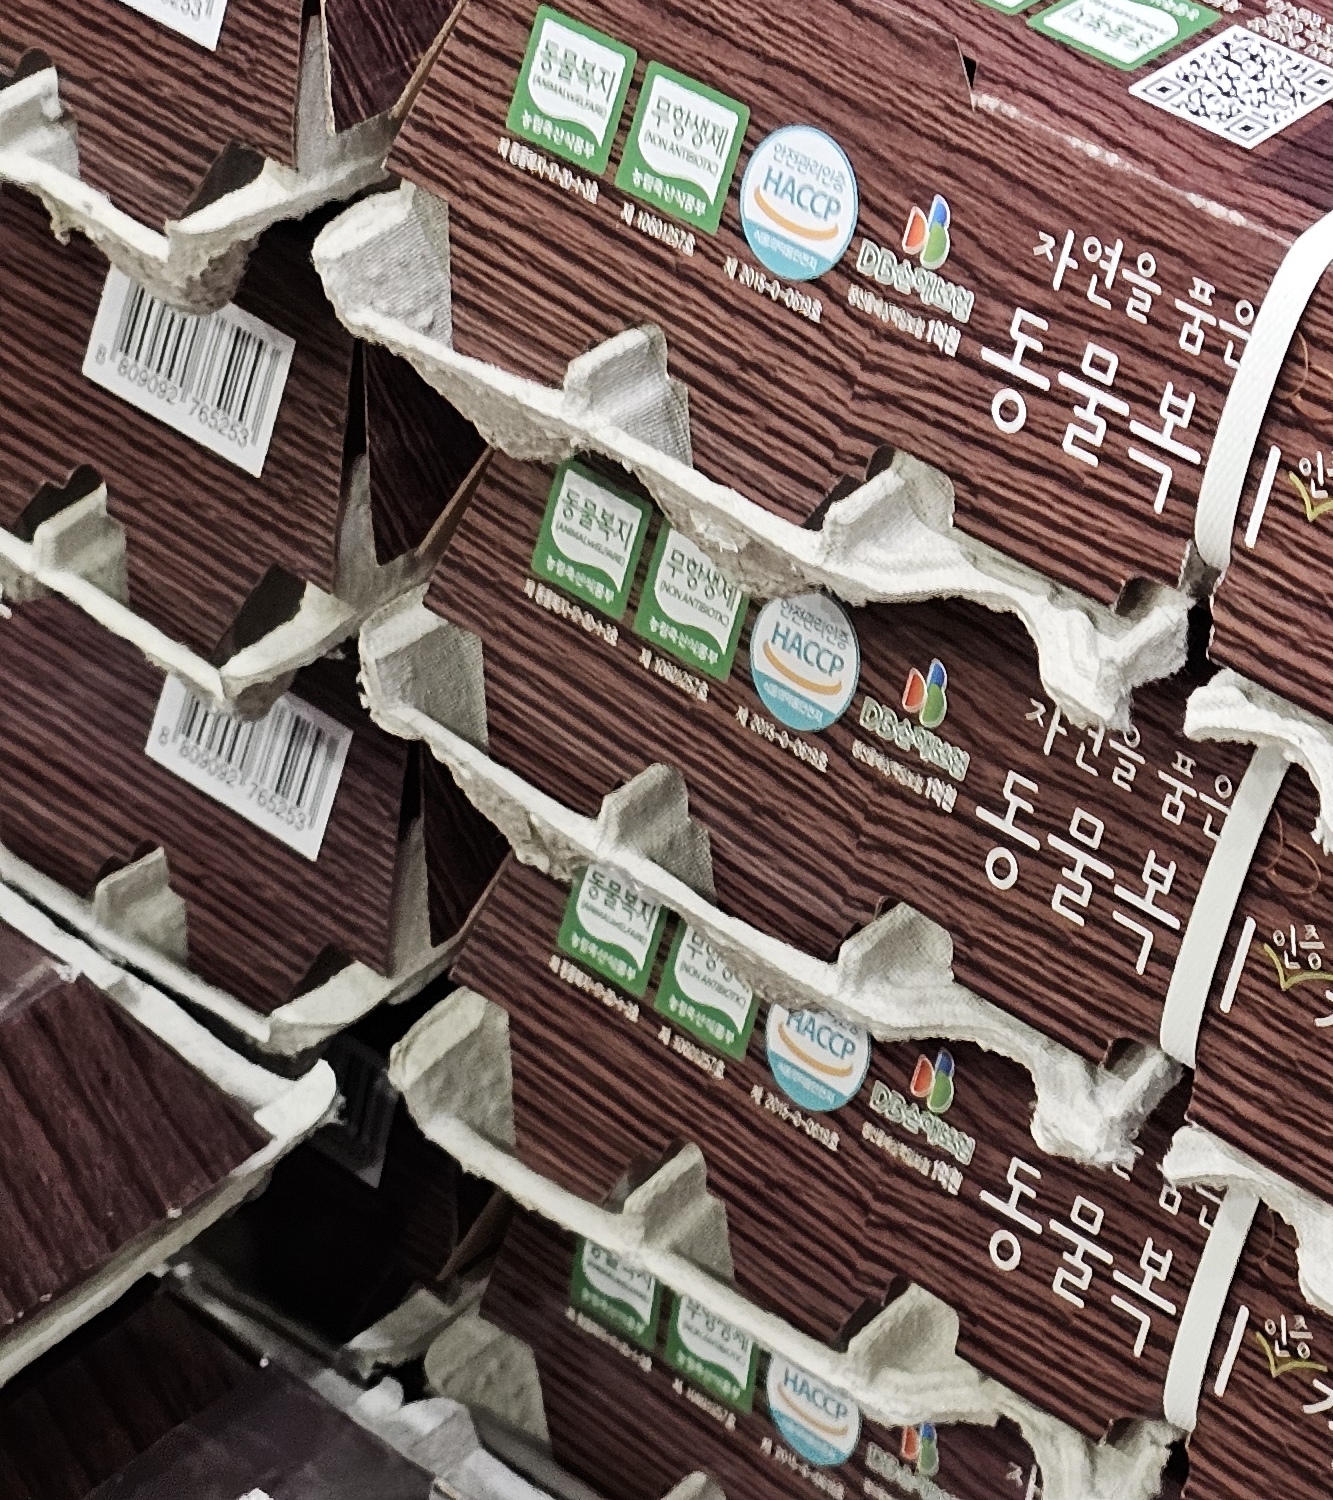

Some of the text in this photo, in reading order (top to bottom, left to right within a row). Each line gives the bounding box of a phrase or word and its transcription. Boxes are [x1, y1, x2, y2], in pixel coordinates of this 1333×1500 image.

[540, 40, 615, 102] 동물복지
[655, 97, 728, 157] 무항생제
[762, 166, 840, 220] HACCP
[1032, 227, 1254, 378] 자연을 품은
[561, 487, 635, 552] 동물복지
[771, 627, 845, 677] HACCP
[1159, 751, 1235, 841] 품은
[1272, 924, 1326, 972] 인증
[1264, 1314, 1315, 1360] 인증
[782, 1367, 848, 1427] HACCP
